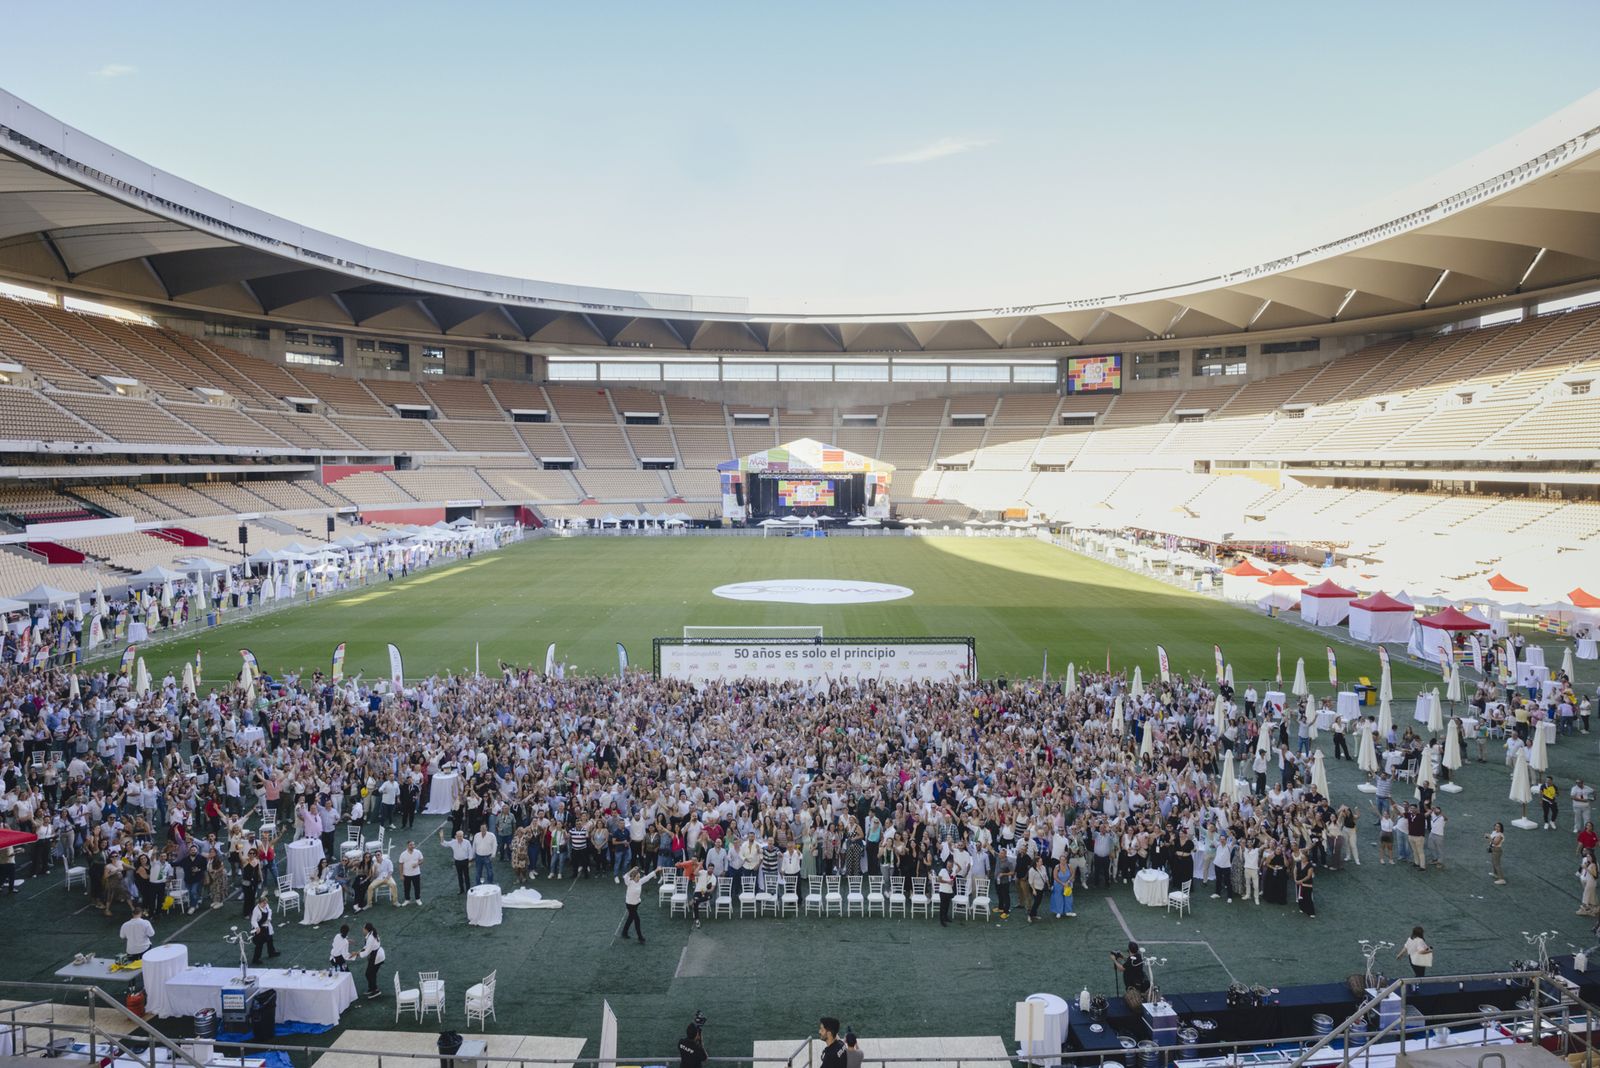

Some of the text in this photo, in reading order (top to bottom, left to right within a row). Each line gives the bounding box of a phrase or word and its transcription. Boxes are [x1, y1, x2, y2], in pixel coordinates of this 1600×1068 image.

[734, 647, 895, 661] 50 años es solo el principio
